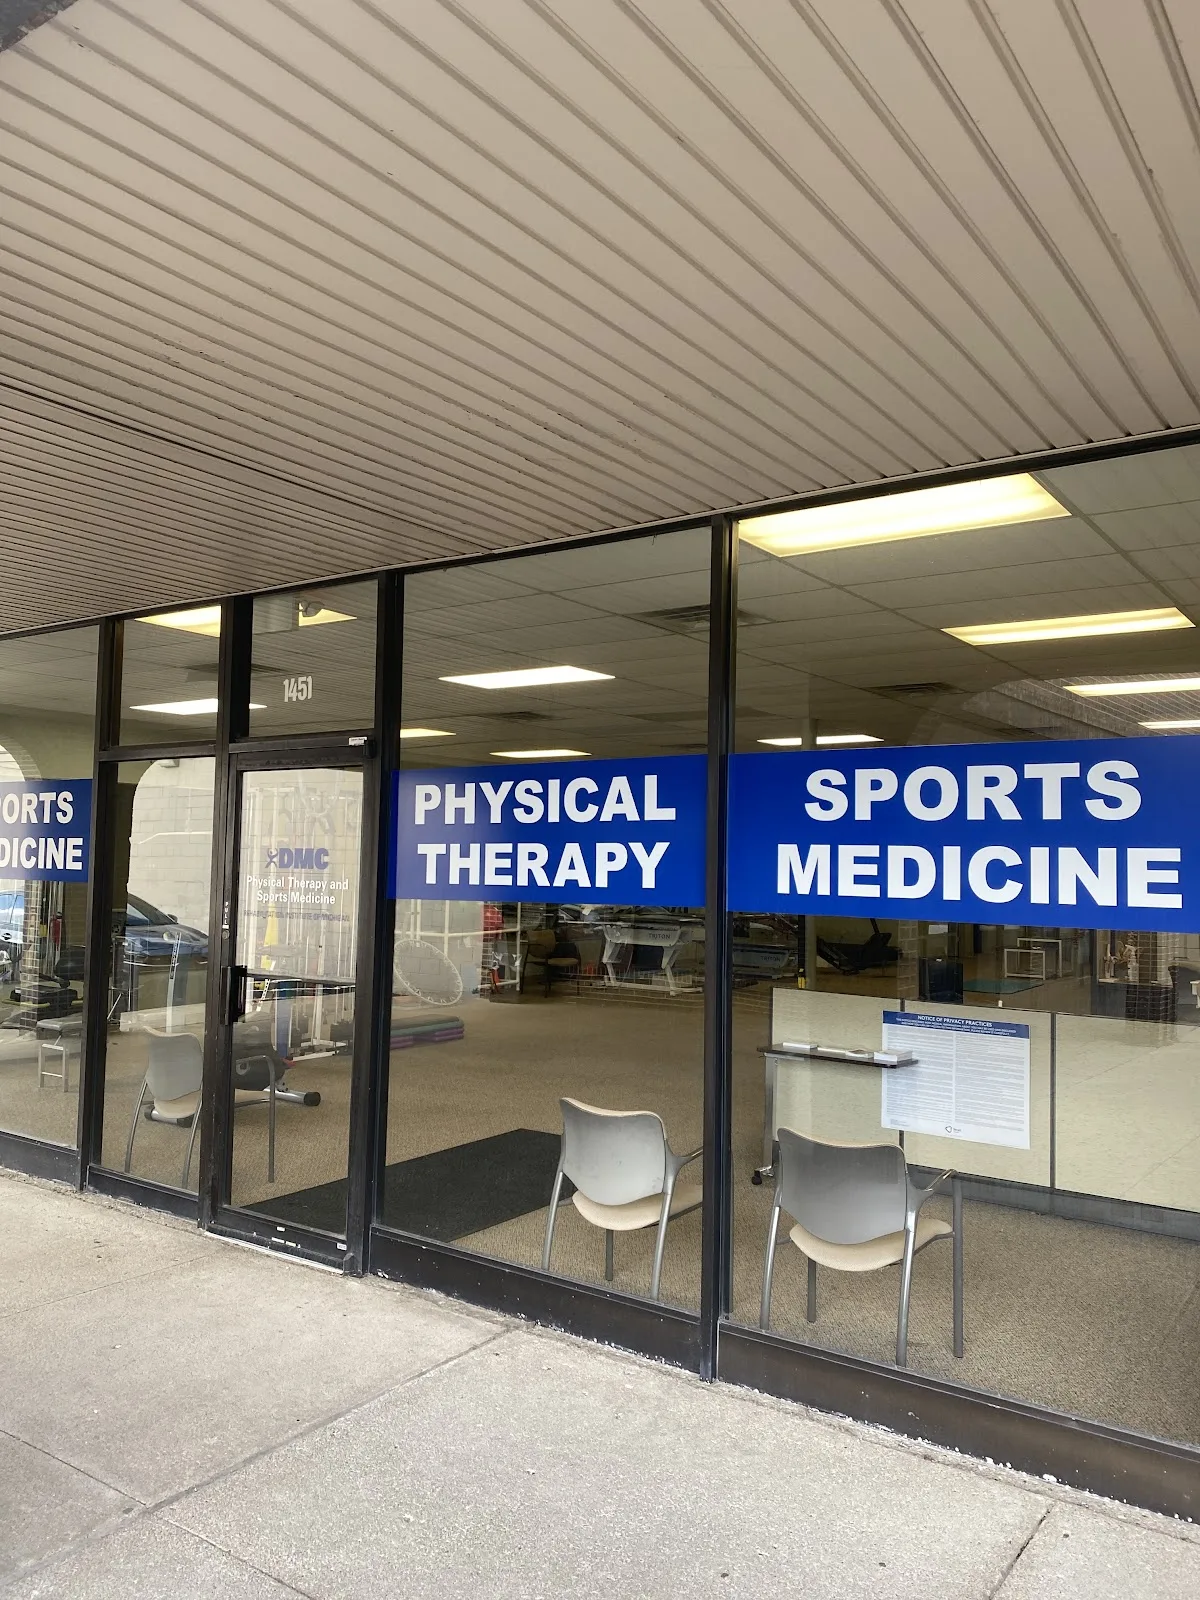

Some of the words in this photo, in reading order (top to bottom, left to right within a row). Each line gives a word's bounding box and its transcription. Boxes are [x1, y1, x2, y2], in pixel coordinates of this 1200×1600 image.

[283, 675, 313, 702] 1451
[414, 775, 676, 824] PHYSICAL
[804, 760, 1142, 821] SPORTS
[0, 791, 74, 824] ORTS
[278, 848, 329, 870] DMC
[417, 842, 670, 889] THERAPY
[247, 875, 285, 888] Physical
[288, 877, 327, 891] Therapy
[330, 879, 349, 890] and
[777, 844, 1183, 909] MEDICINE
[257, 890, 288, 904] Sports
[291, 891, 336, 905] Medicine
[648, 932, 671, 940] TRITON
[965, 1020, 993, 1028] PRACTICES
